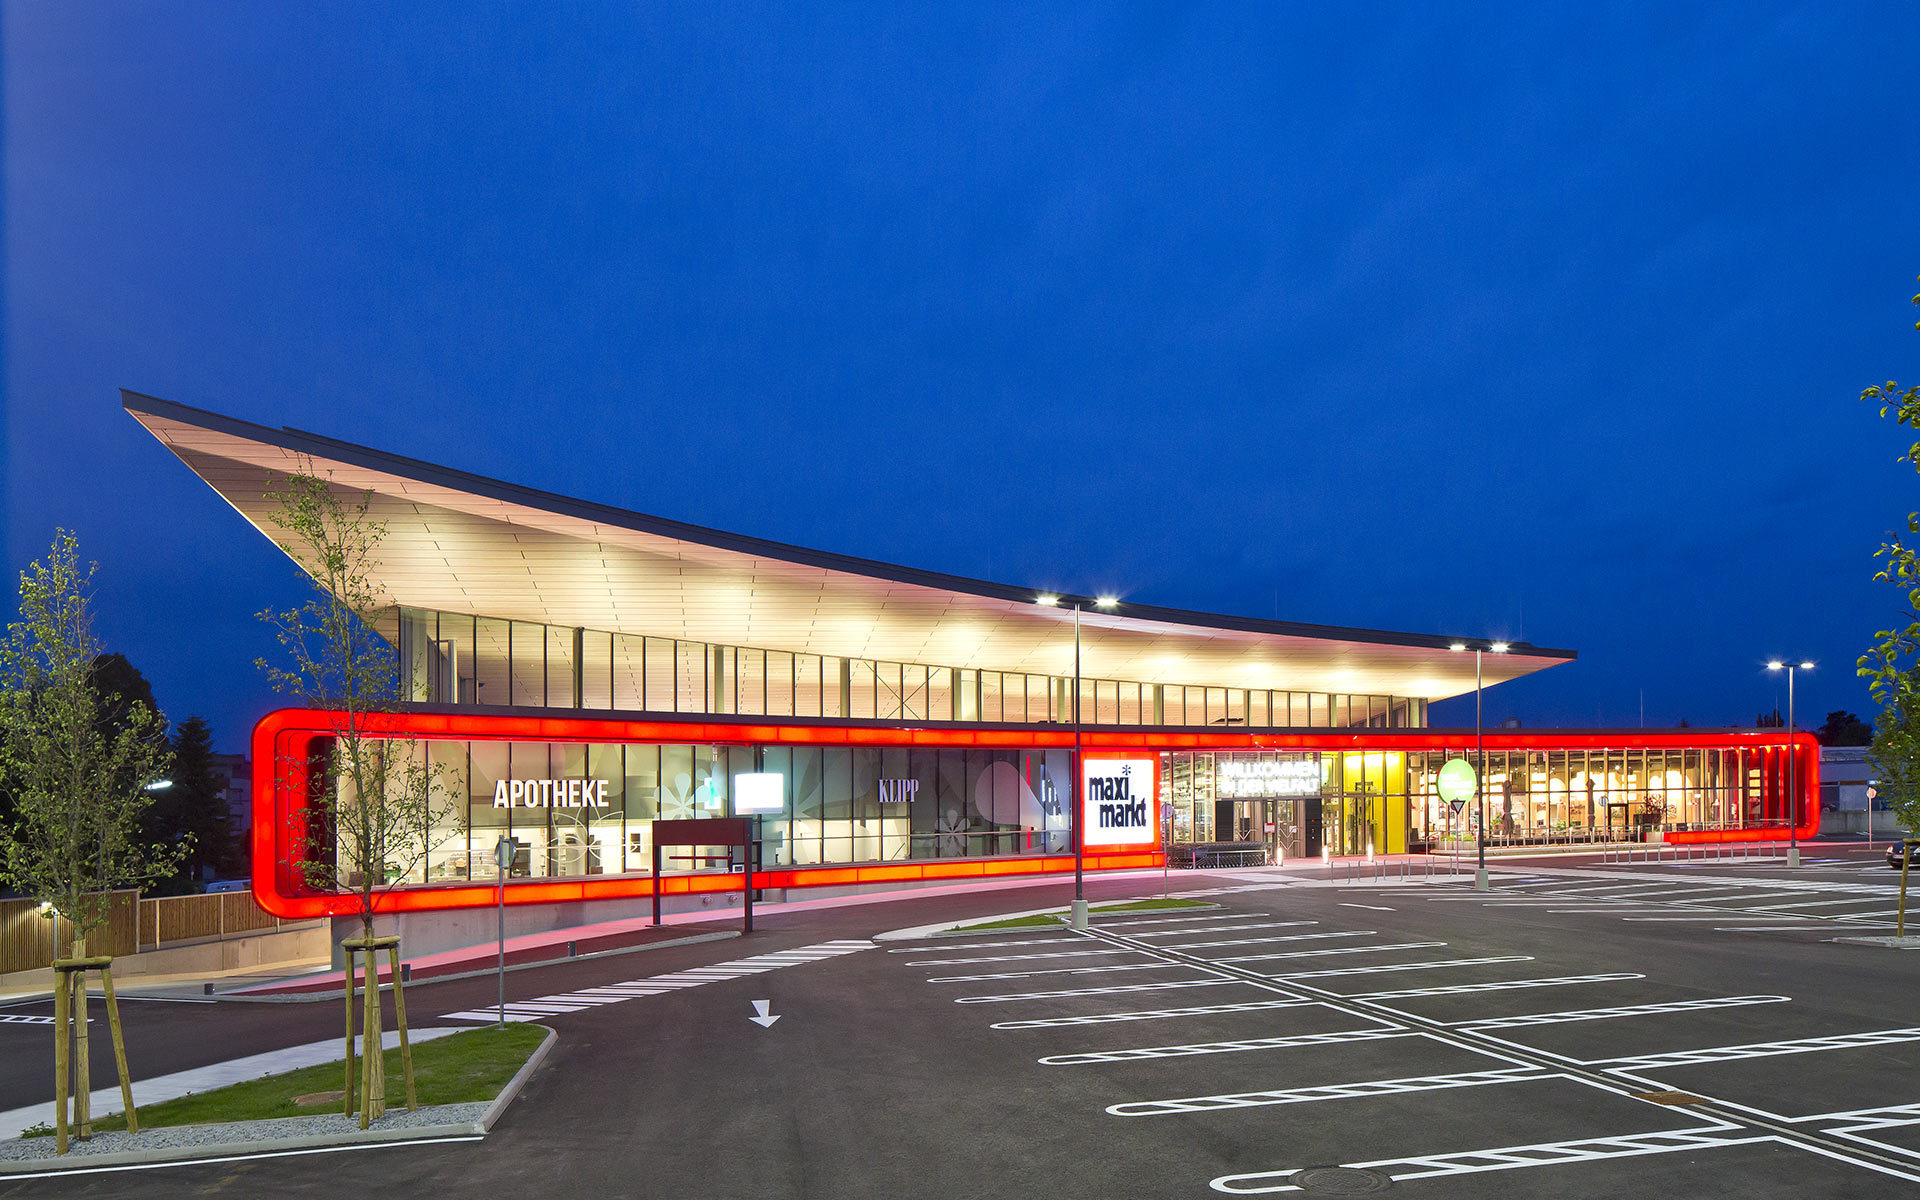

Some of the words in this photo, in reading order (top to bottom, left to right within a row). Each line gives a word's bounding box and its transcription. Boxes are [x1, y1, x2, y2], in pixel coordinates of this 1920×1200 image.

[493, 779, 609, 808] APOTHEKE
[879, 779, 919, 803] KLIPP
[1089, 765, 1131, 800] maxi
[1099, 794, 1146, 827] markt
